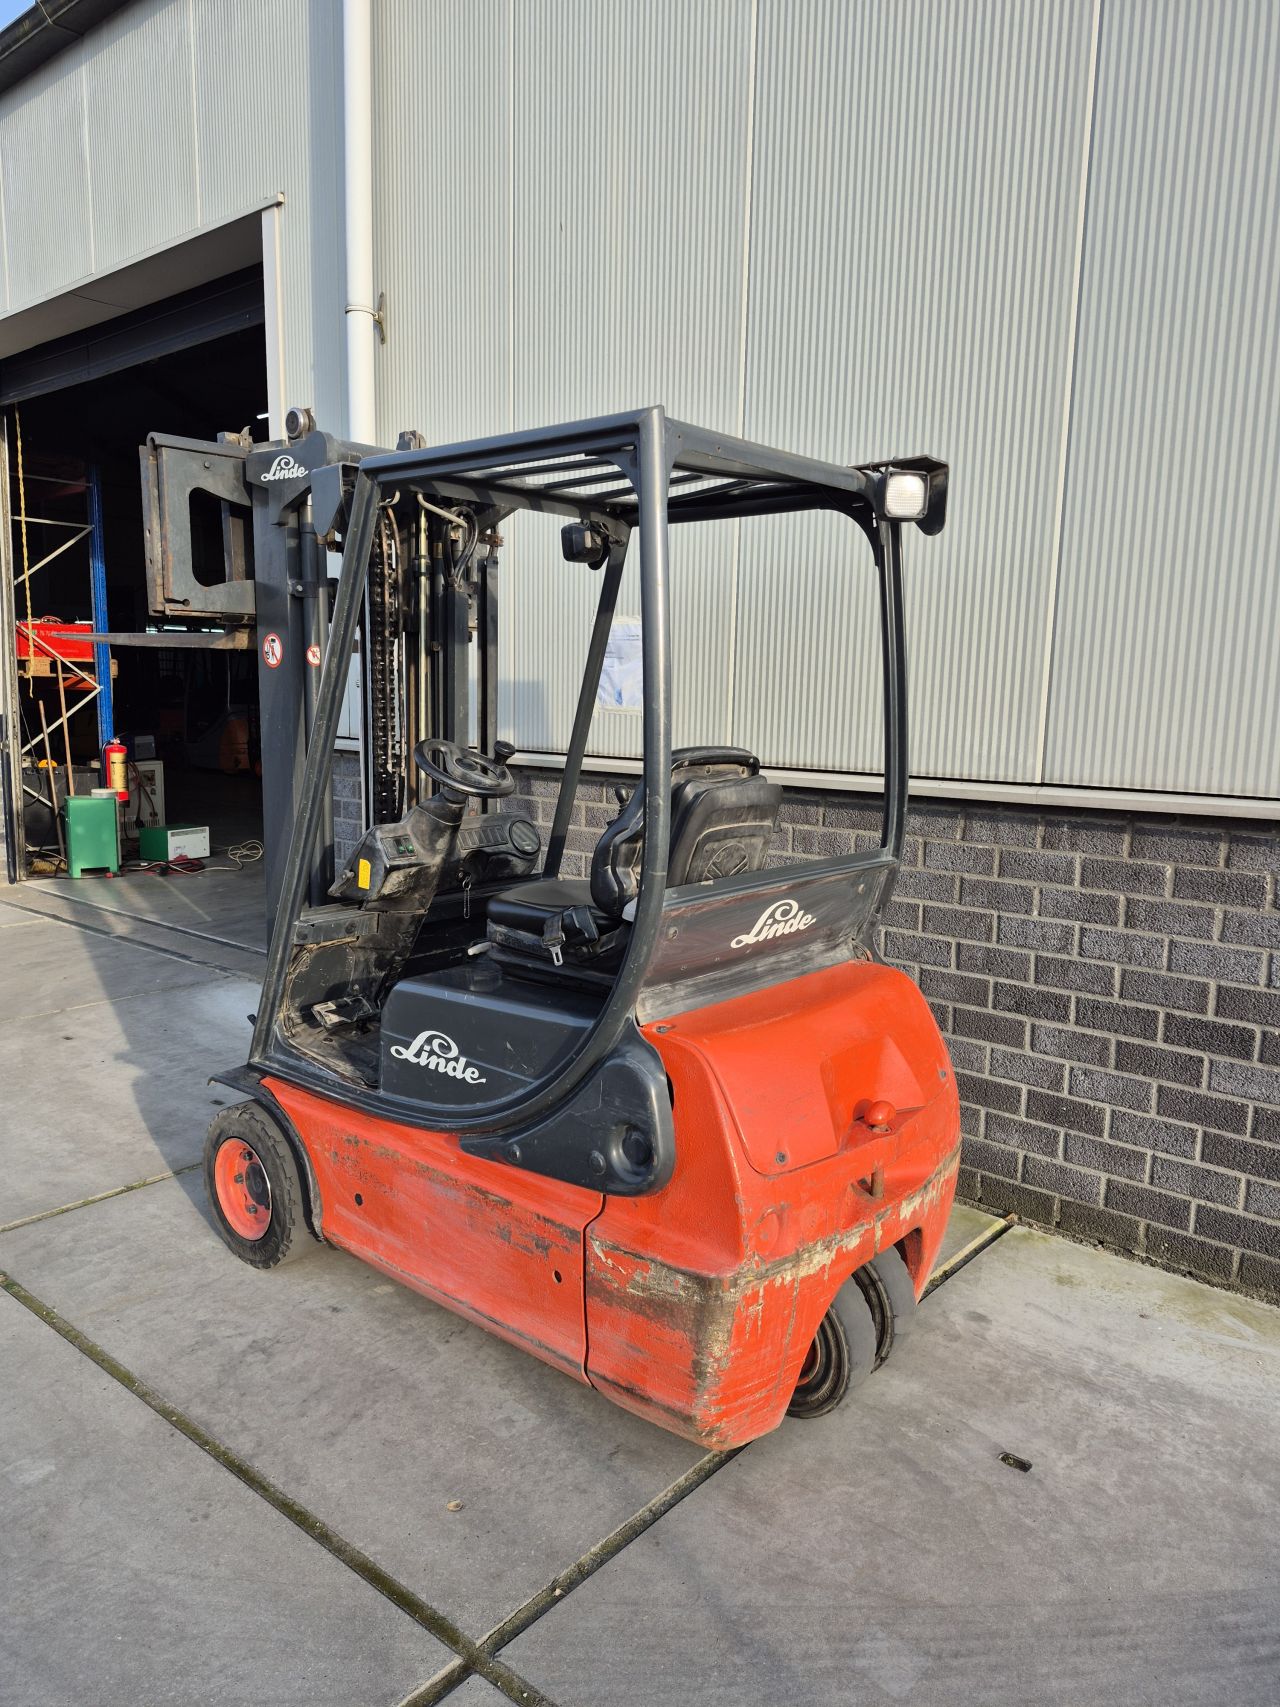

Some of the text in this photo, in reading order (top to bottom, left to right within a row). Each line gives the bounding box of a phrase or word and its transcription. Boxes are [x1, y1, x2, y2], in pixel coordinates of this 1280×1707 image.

[261, 455, 309, 482] Linde
[730, 899, 817, 949] Linde
[391, 1031, 487, 1084] Linde
